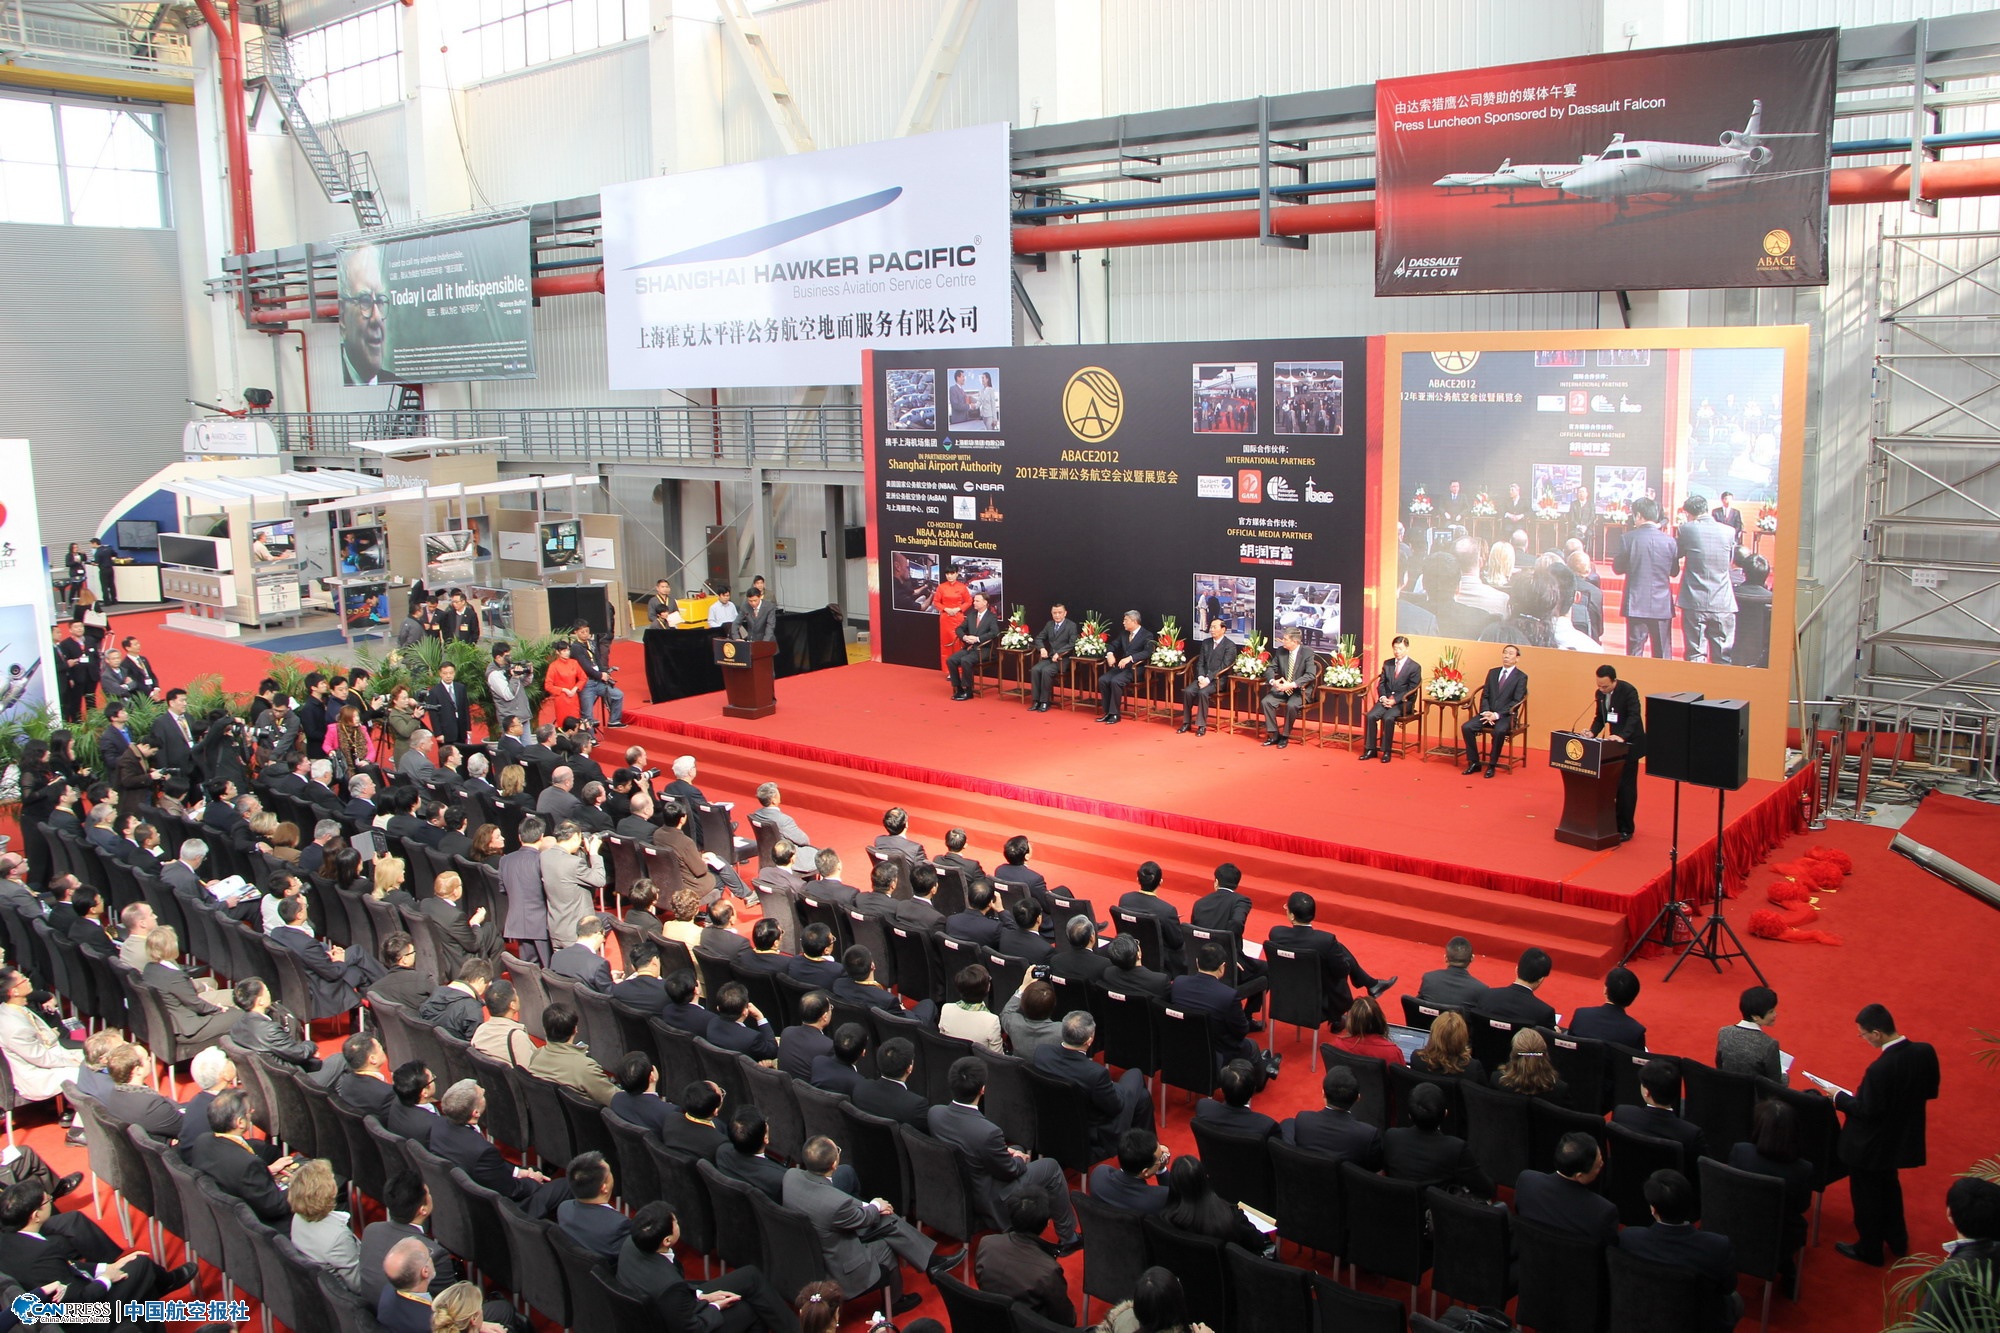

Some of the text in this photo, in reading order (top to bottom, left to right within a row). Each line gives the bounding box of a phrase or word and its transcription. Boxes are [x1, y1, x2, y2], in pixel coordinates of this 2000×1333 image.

[1395, 84, 1577, 114] 由达索猎鹰公司赞助的媒体午宴
[1394, 97, 1666, 132] Press Luncheon Sponsored by Dassault Falcon
[1408, 256, 1462, 267] DASSAULT
[1757, 256, 1796, 266] ABACE
[634, 267, 746, 295] SHANGHAI
[755, 255, 858, 284] HAWKER
[1404, 268, 1458, 278] FALCON
[390, 274, 528, 307] Today I call it Indispensible.
[793, 274, 976, 298] Business Aviation Service Centre
[636, 305, 979, 350] 上海霍克太平洋公务航空地面服务有限公司
[1429, 379, 1476, 388] ABACE2012
[1061, 450, 1119, 462] ABACE2012
[1226, 456, 1316, 466] INTERNATIONAL PARTNERS
[888, 458, 1002, 475] Shanghai Airport Authority
[386, 474, 430, 488] BBA Aviation
[1016, 467, 1179, 484] 2012年亚洲公务航空会议暨展览会
[975, 483, 1004, 492] NBAA
[916, 528, 973, 539] NBAA, AsBAA and
[1227, 529, 1313, 540] OFFICIAL MEDIA PARTNER
[894, 534, 997, 550] The Shanghai Exhibition Centre
[1240, 543, 1293, 560] 胡润百富
